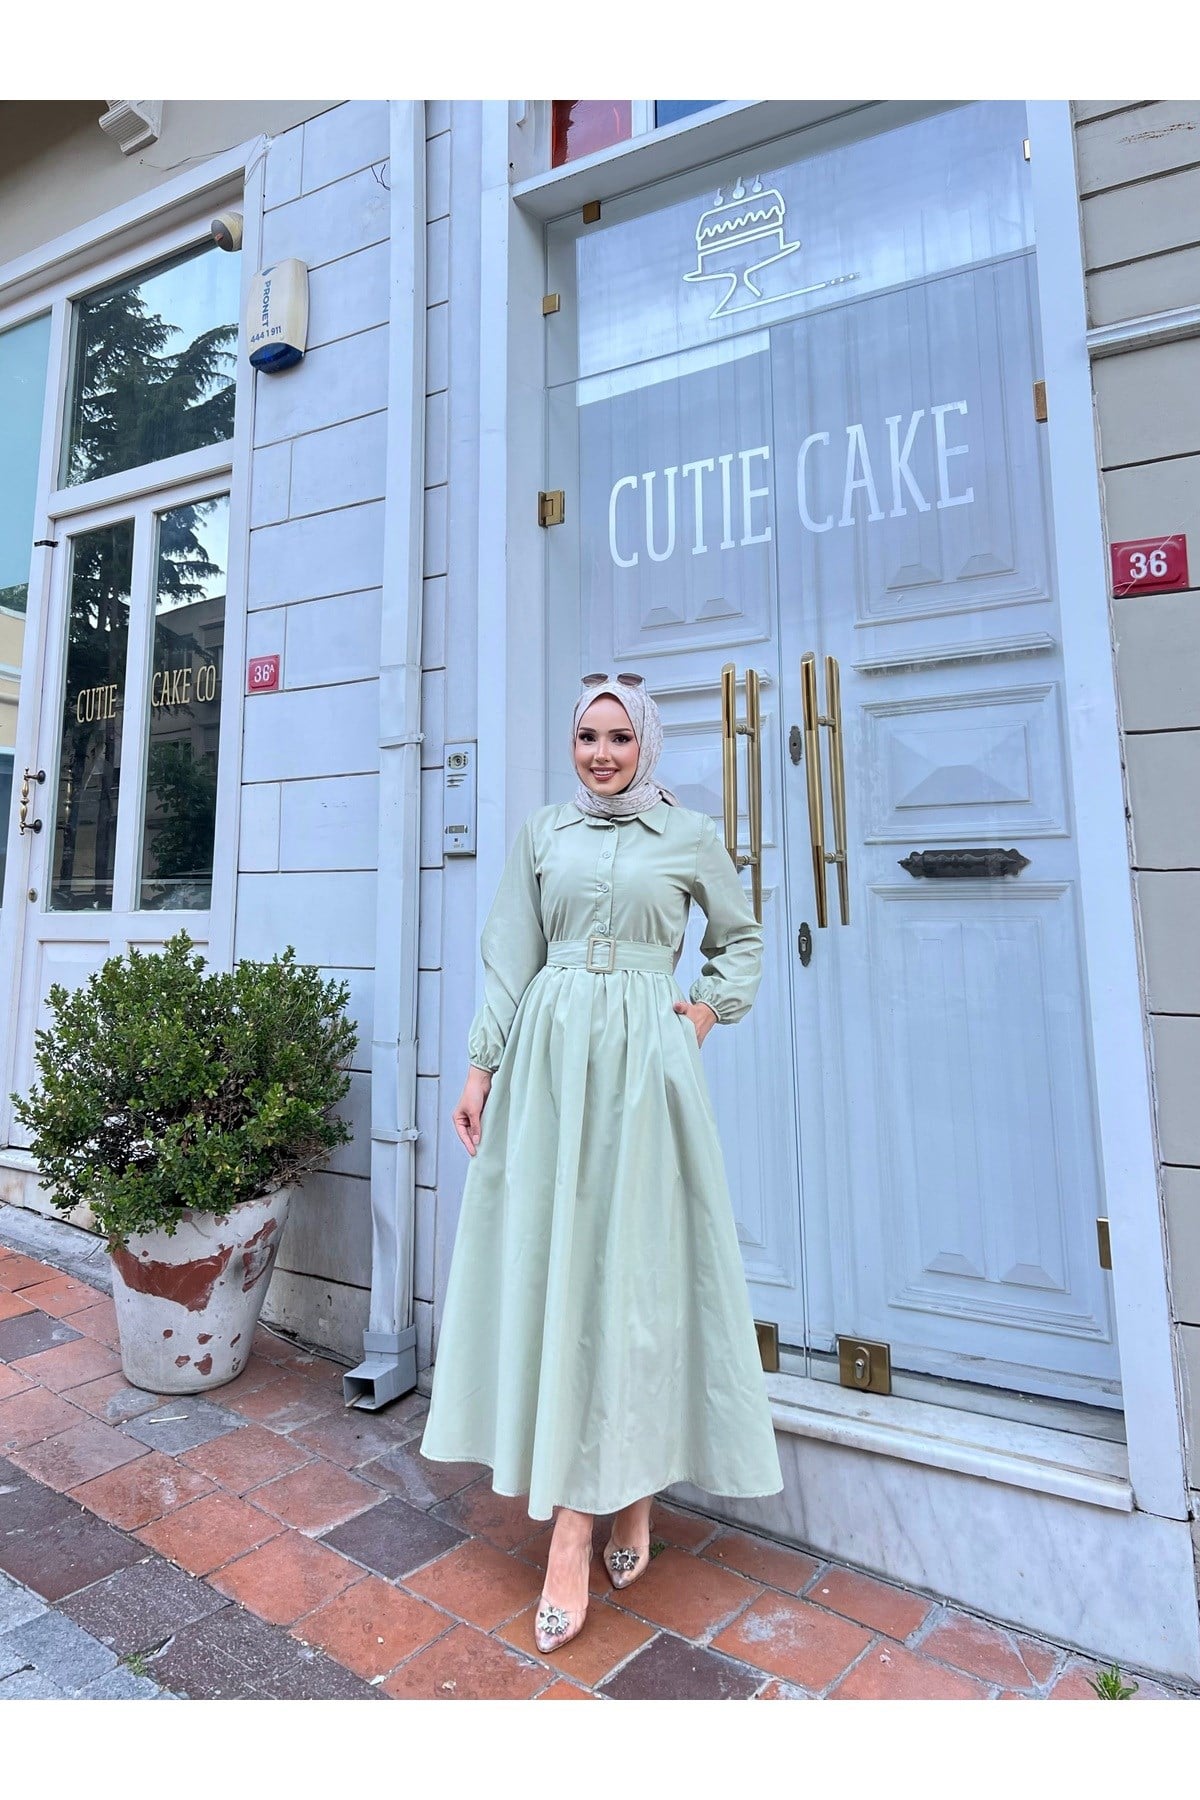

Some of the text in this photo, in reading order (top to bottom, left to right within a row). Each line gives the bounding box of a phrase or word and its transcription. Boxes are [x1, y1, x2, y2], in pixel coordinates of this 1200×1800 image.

[262, 280, 271, 327] PRONET
[251, 331, 265, 343] 444
[271, 325, 282, 336] 911
[608, 400, 974, 568] CUTIE CAKE
[1129, 549, 1168, 579] 36
[76, 664, 217, 724] CUTIE CAKE CO
